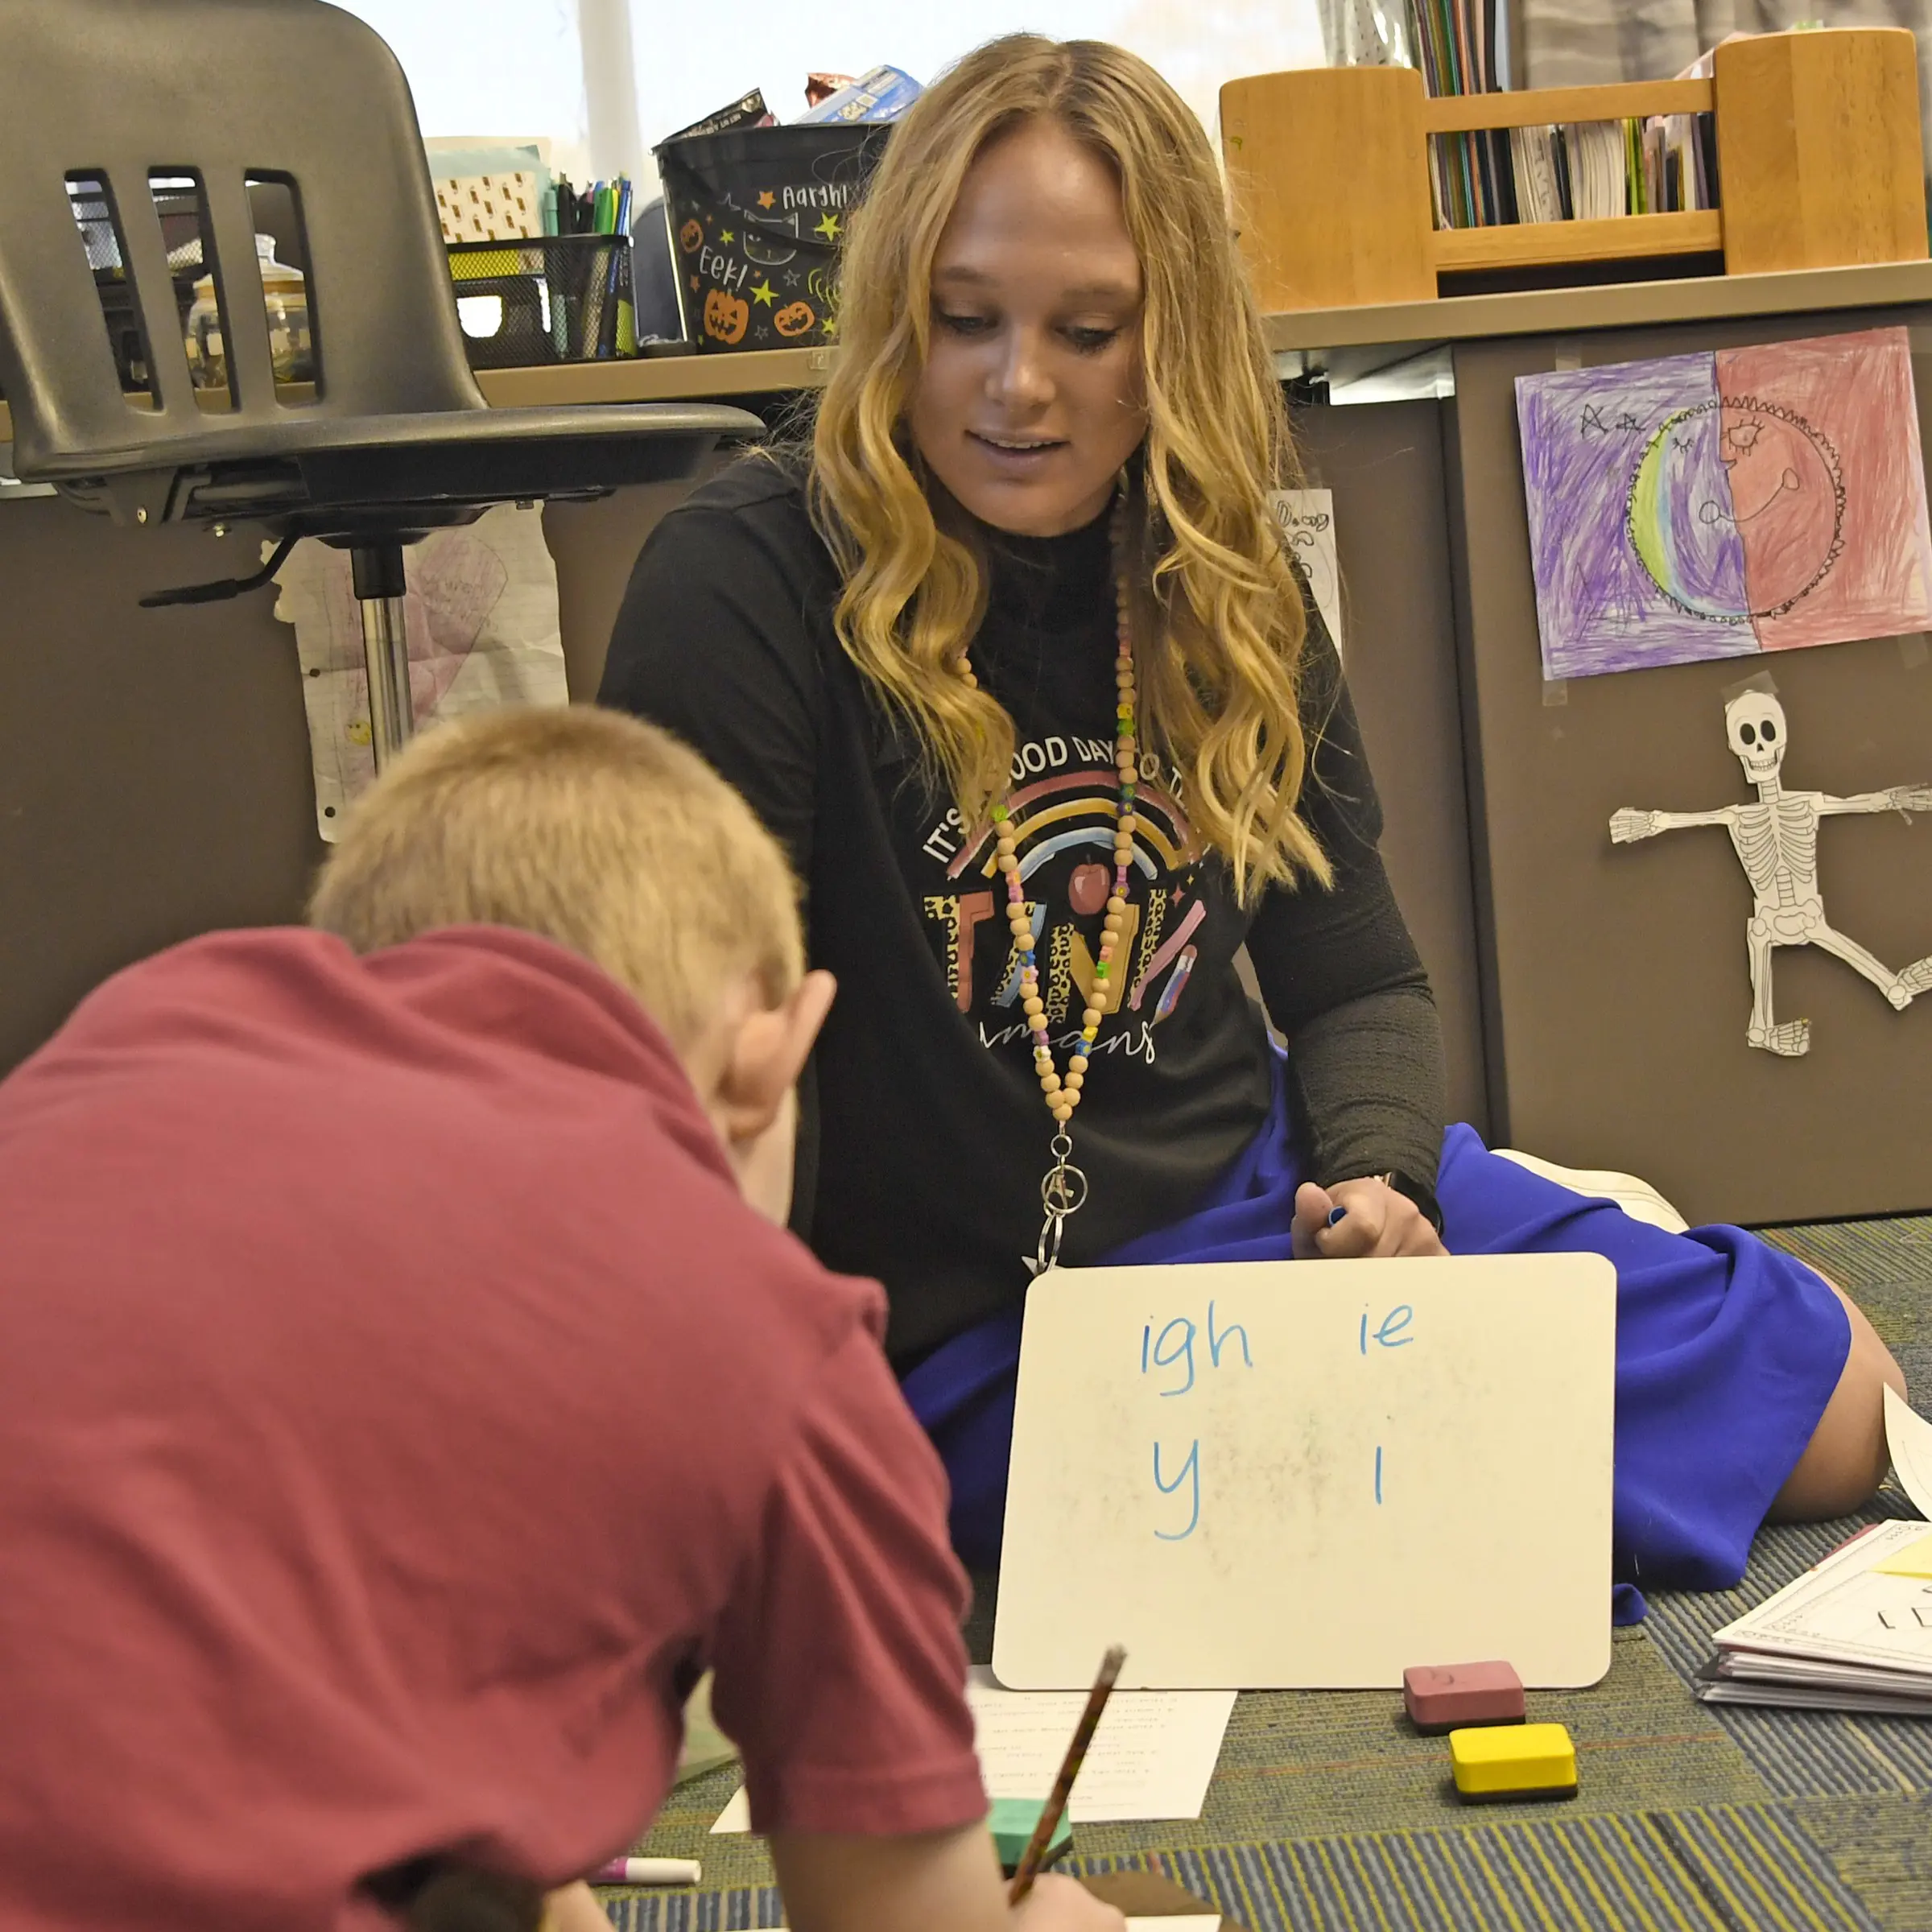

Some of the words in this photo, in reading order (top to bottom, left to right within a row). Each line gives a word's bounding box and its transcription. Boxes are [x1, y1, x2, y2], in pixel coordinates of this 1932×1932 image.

[782, 184, 847, 209] Aargh!
[700, 245, 748, 291] Eek!
[922, 807, 971, 864] IT'S
[1009, 736, 1068, 782] OOD
[1071, 736, 1115, 765] DAY
[1141, 1299, 1253, 1397] igh
[1360, 1302, 1414, 1356] ie
